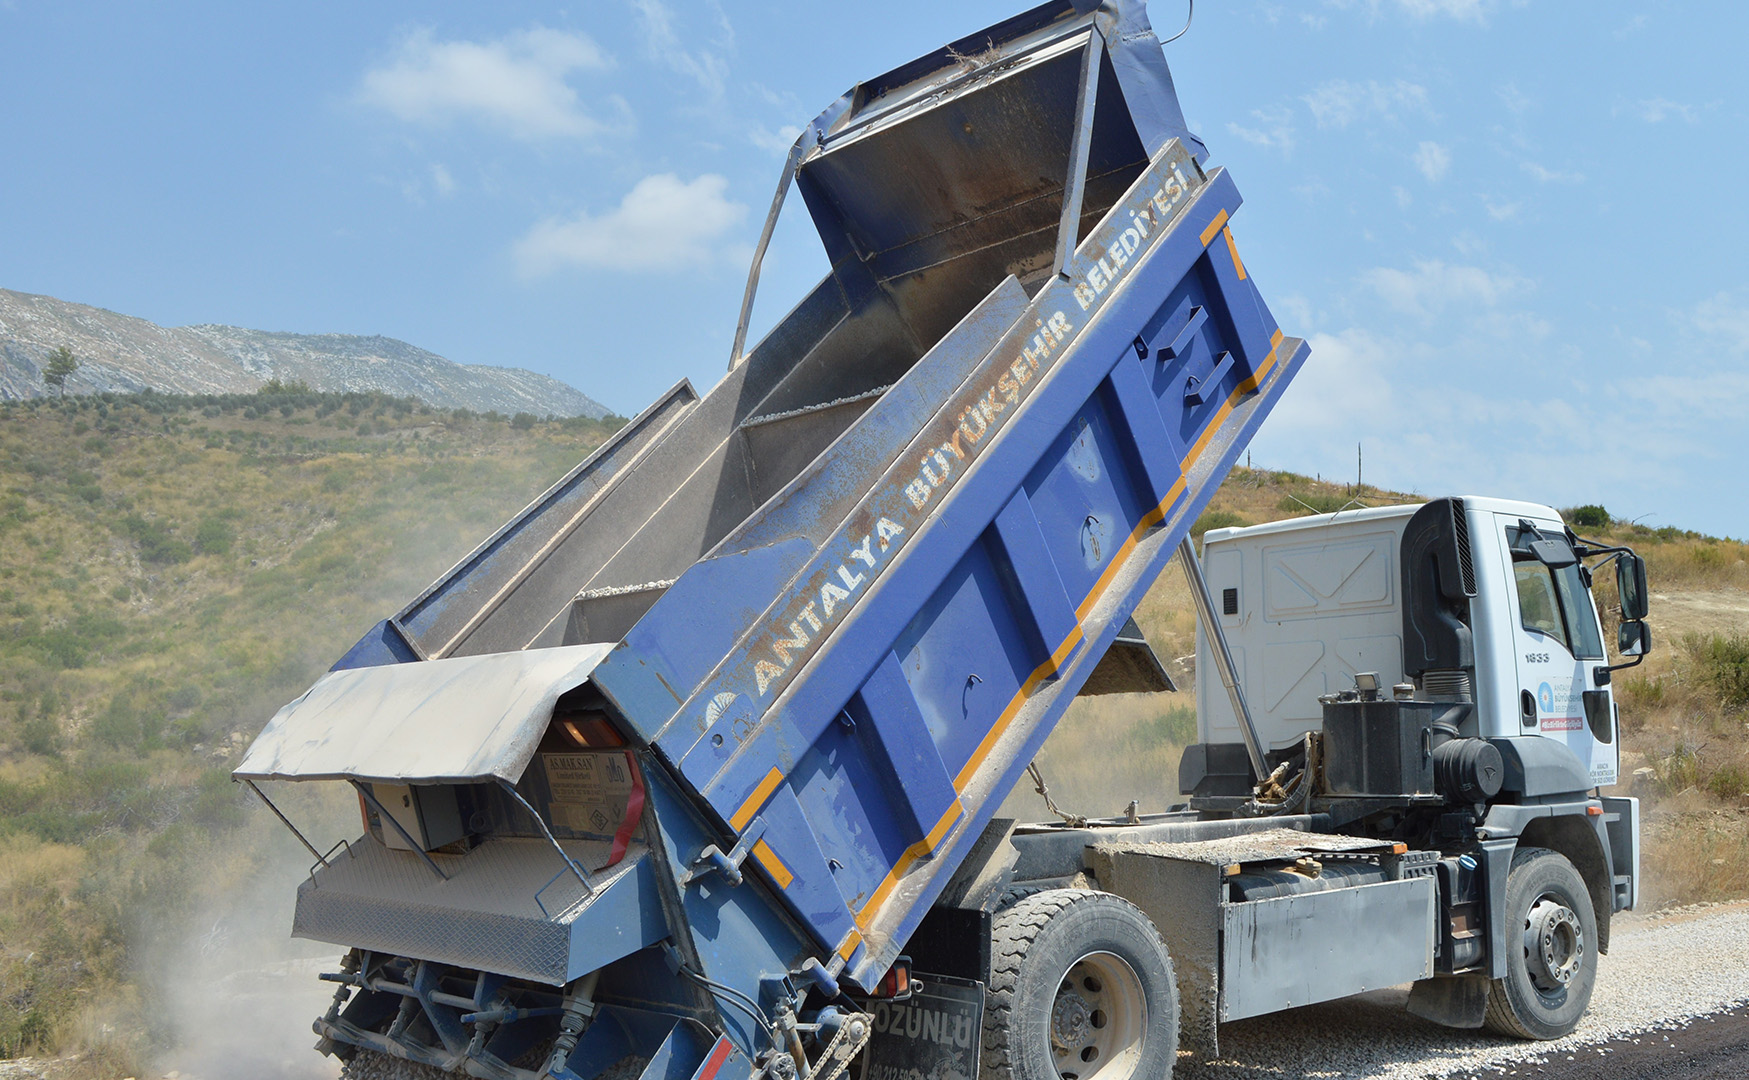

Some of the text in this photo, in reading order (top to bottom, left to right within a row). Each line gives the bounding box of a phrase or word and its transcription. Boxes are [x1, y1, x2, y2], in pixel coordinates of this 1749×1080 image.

[752, 161, 1189, 696] ANTALYA BÜYÜKŞEHİR BELEDİYESİ
